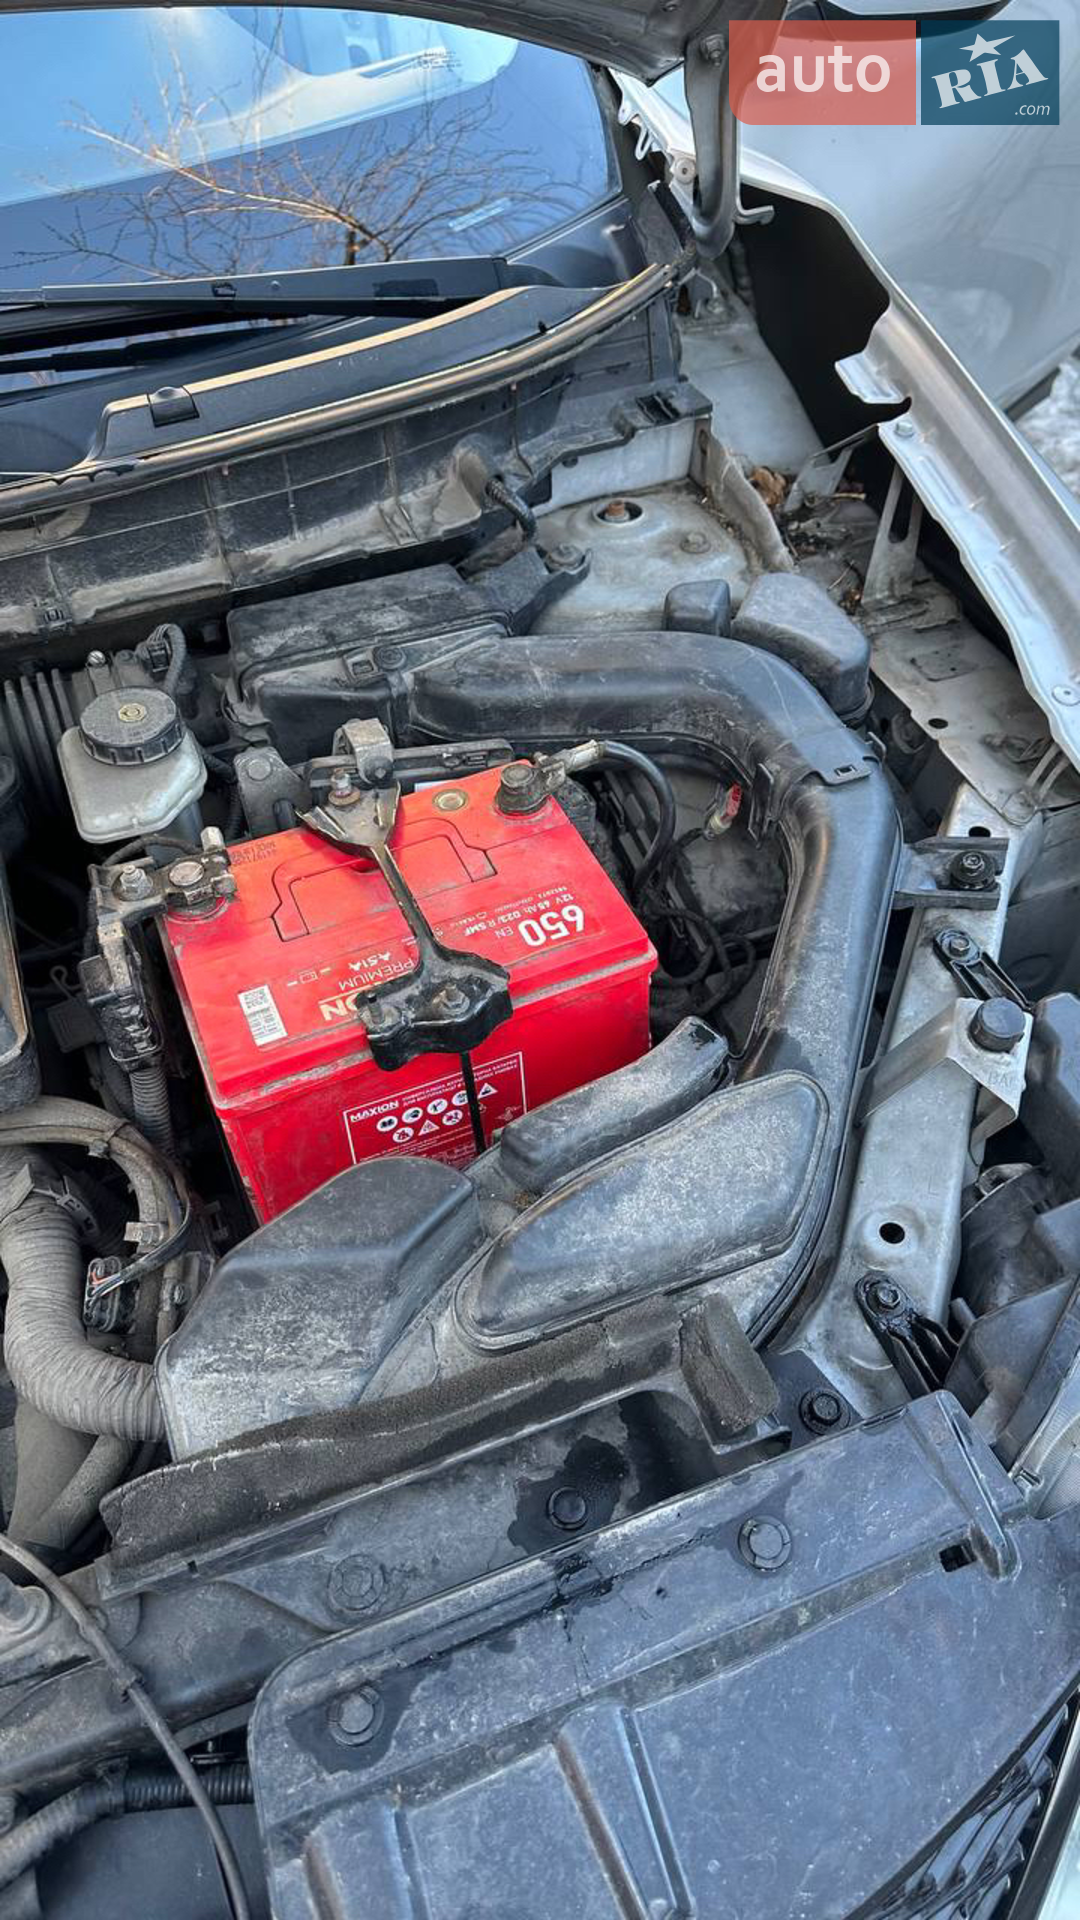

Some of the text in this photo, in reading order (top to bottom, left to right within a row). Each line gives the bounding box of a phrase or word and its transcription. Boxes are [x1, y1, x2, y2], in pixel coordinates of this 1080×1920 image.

[495, 926, 514, 938] EN
[518, 905, 585, 947] 650
[348, 951, 391, 972] ASIA
[339, 958, 415, 991] PREMIUM
[350, 1100, 400, 1123] MAXION
